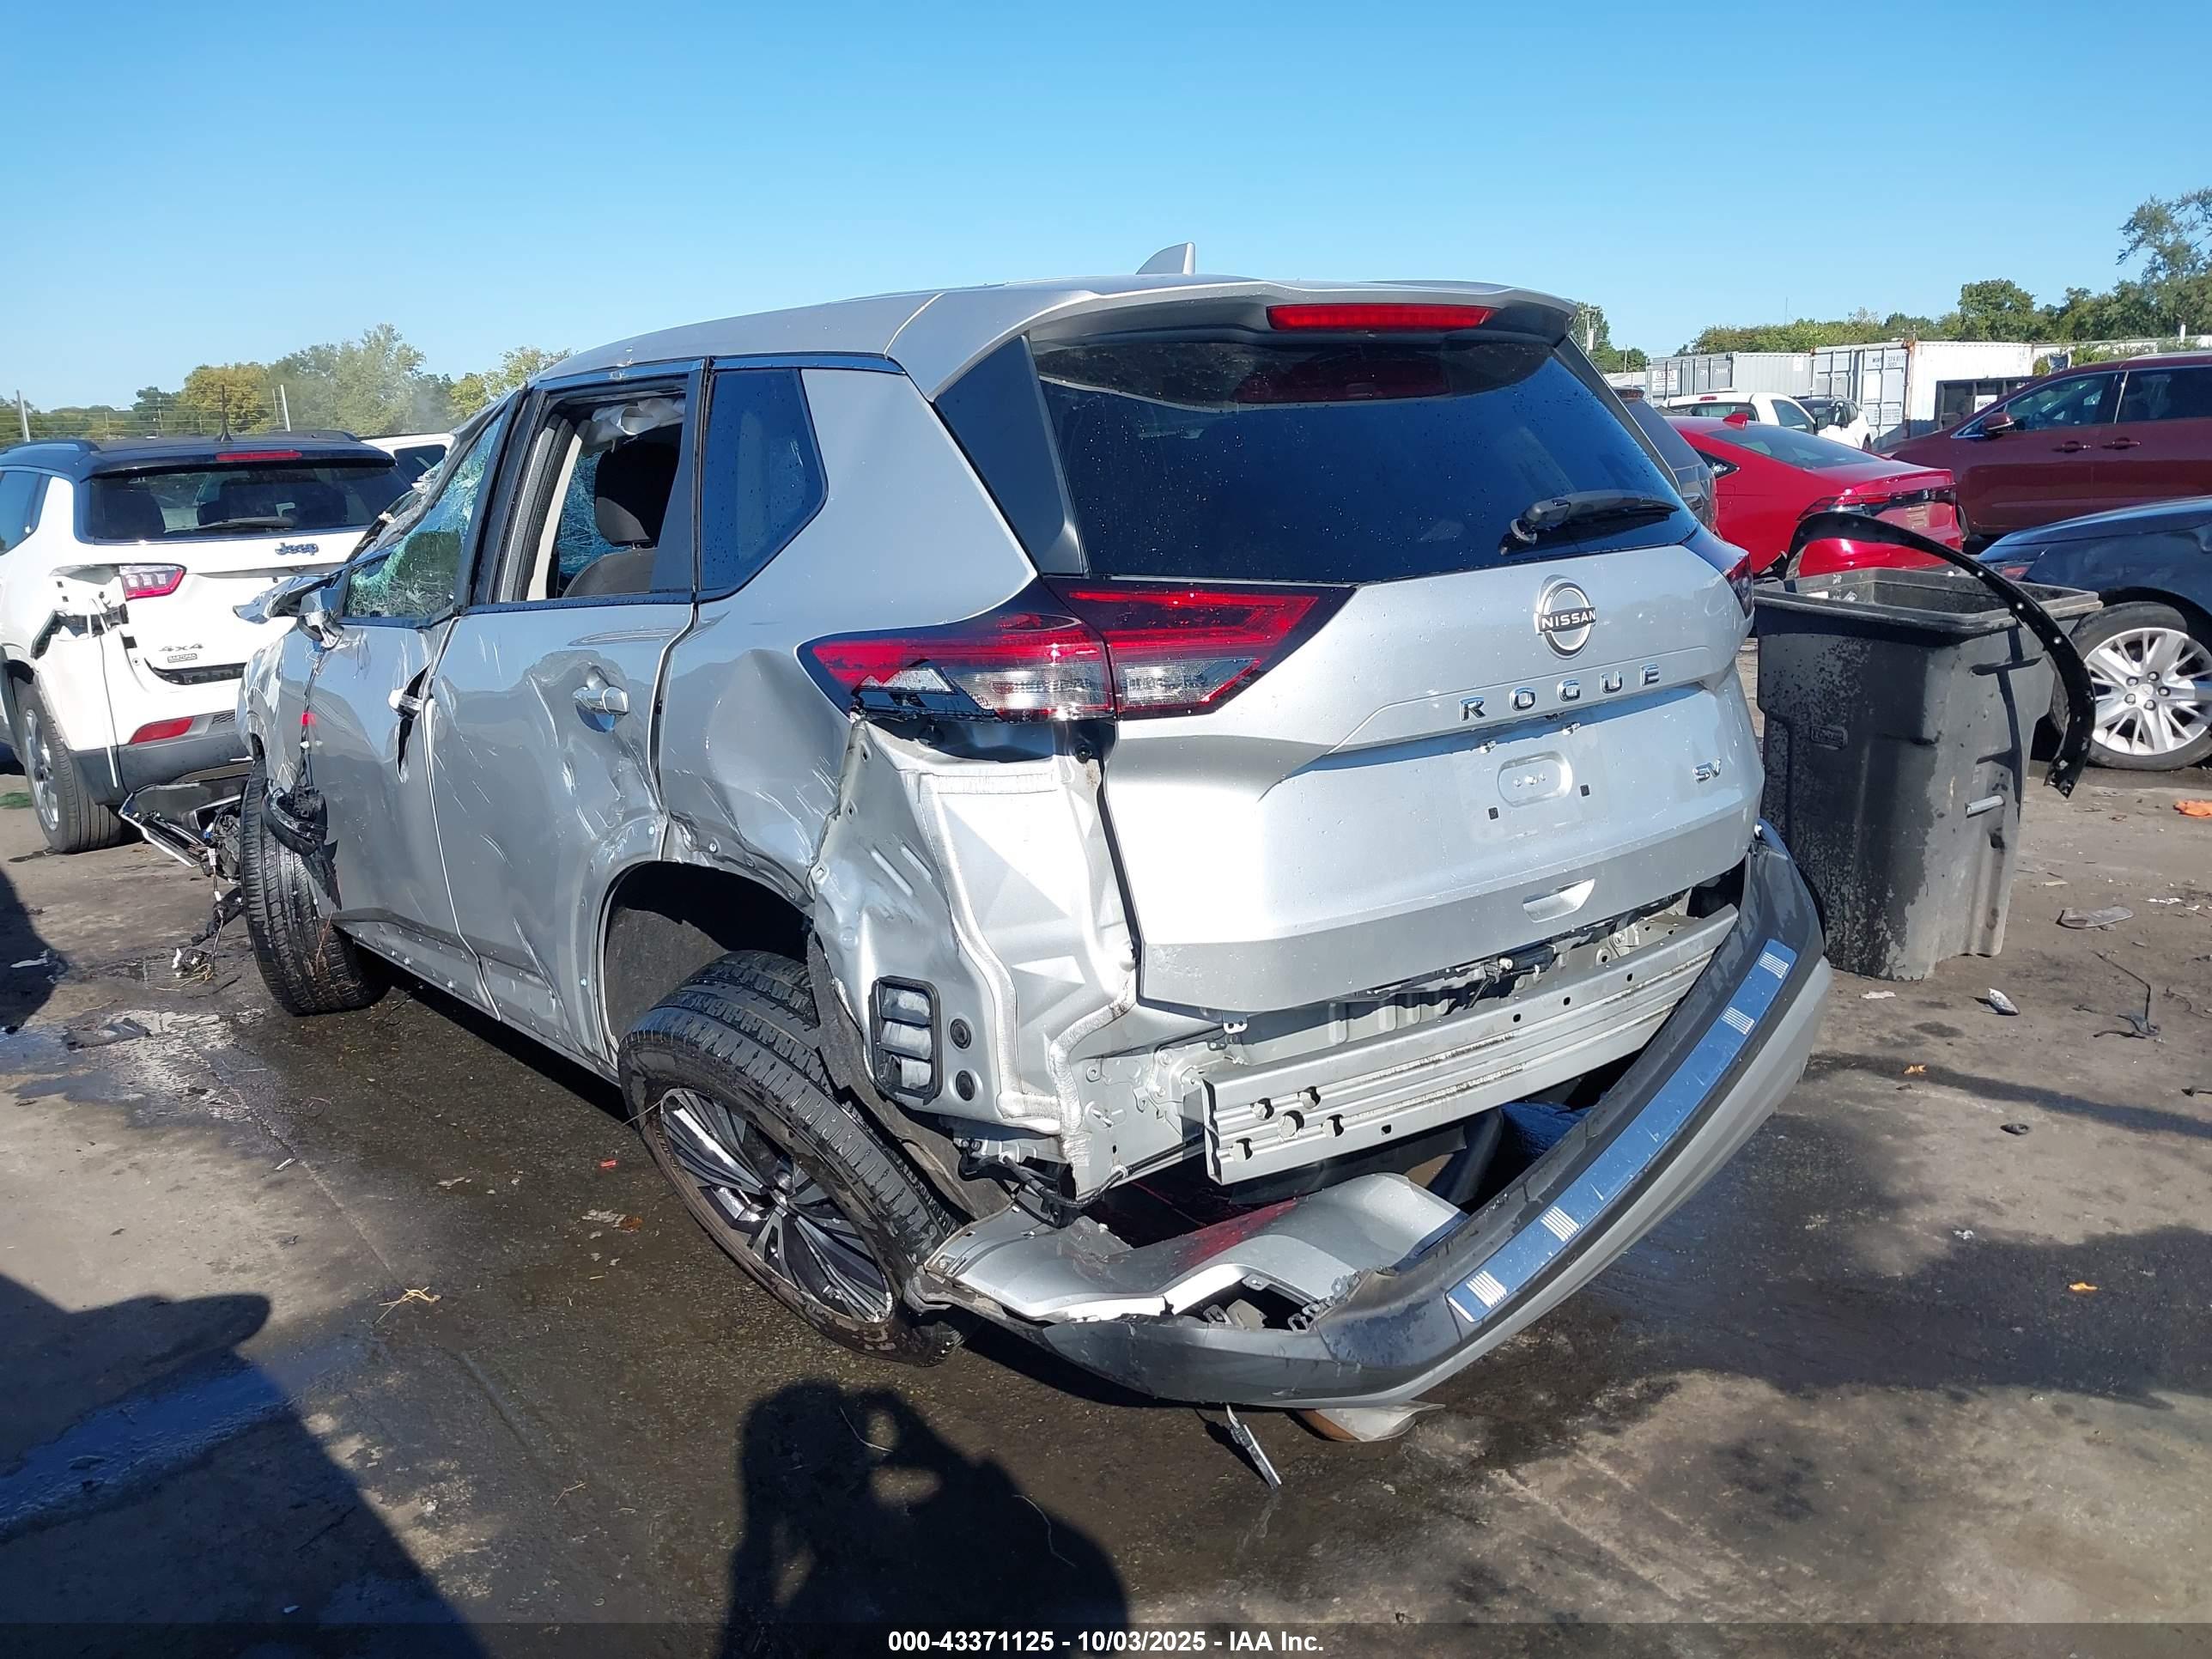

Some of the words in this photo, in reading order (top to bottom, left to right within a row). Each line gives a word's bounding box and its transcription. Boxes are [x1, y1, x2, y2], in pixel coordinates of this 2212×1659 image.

[275, 542, 319, 556] Jeep
[1540, 610, 1597, 629] NISSAN
[1459, 663, 1661, 722] ROGUE
[1692, 757, 1723, 784] SV
